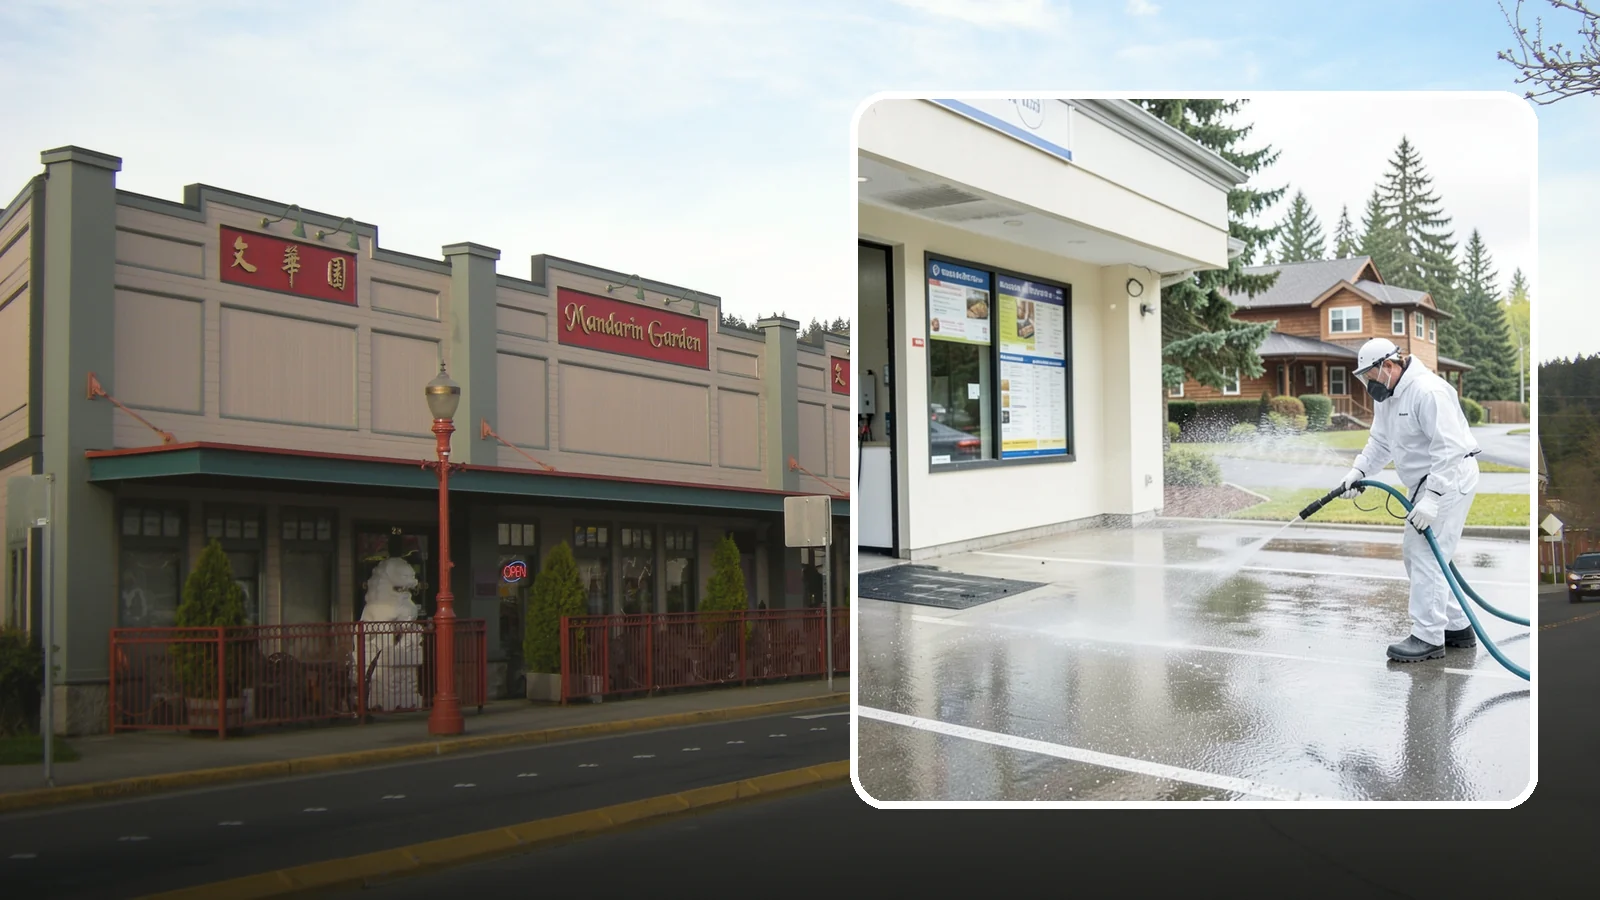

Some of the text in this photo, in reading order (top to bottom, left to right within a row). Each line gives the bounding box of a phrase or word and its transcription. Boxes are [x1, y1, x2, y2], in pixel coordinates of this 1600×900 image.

[231, 236, 346, 291] 文華園
[564, 302, 701, 353] Mandarin Garden
[503, 566, 526, 578] OPEN
